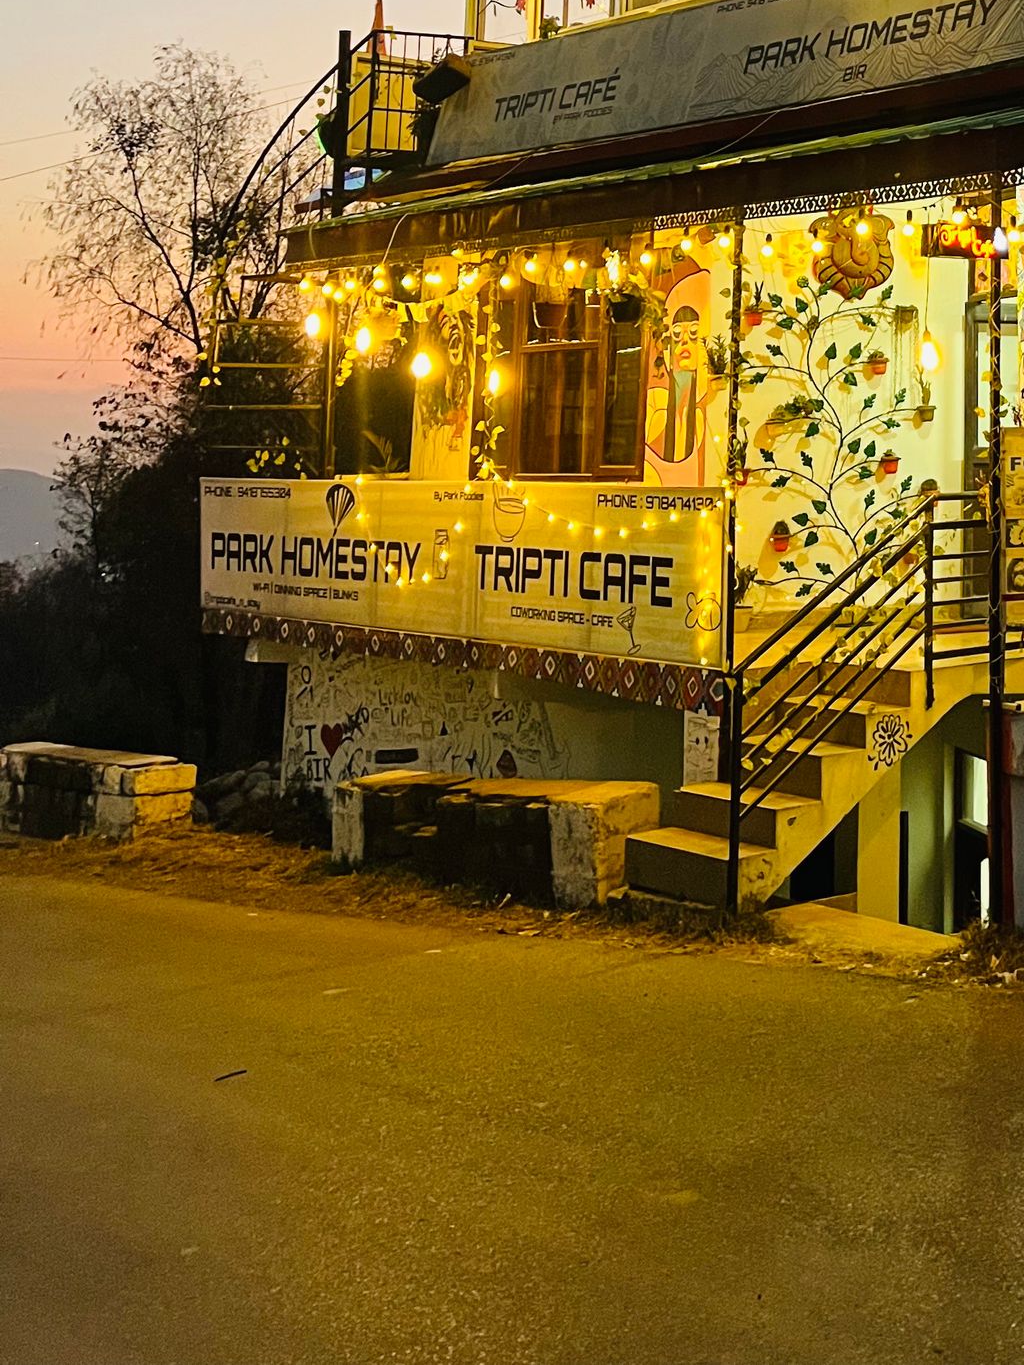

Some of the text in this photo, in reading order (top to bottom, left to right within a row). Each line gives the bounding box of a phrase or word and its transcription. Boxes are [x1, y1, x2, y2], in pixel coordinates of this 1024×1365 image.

[743, 32, 822, 75] PARK
[842, 64, 868, 83] BIR
[494, 67, 621, 122] TRIPTI CAFÉ
[597, 493, 637, 508] PHONE
[211, 532, 421, 584] PARK HOMESTAY
[475, 545, 673, 608] TRIPTI CAFE
[332, 589, 358, 601] BUNKS
[511, 606, 556, 622] COWORKING
[557, 611, 585, 625] SPACE
[592, 613, 613, 628] CAFE
[304, 724, 317, 755] I
[306, 758, 332, 781] BIR
